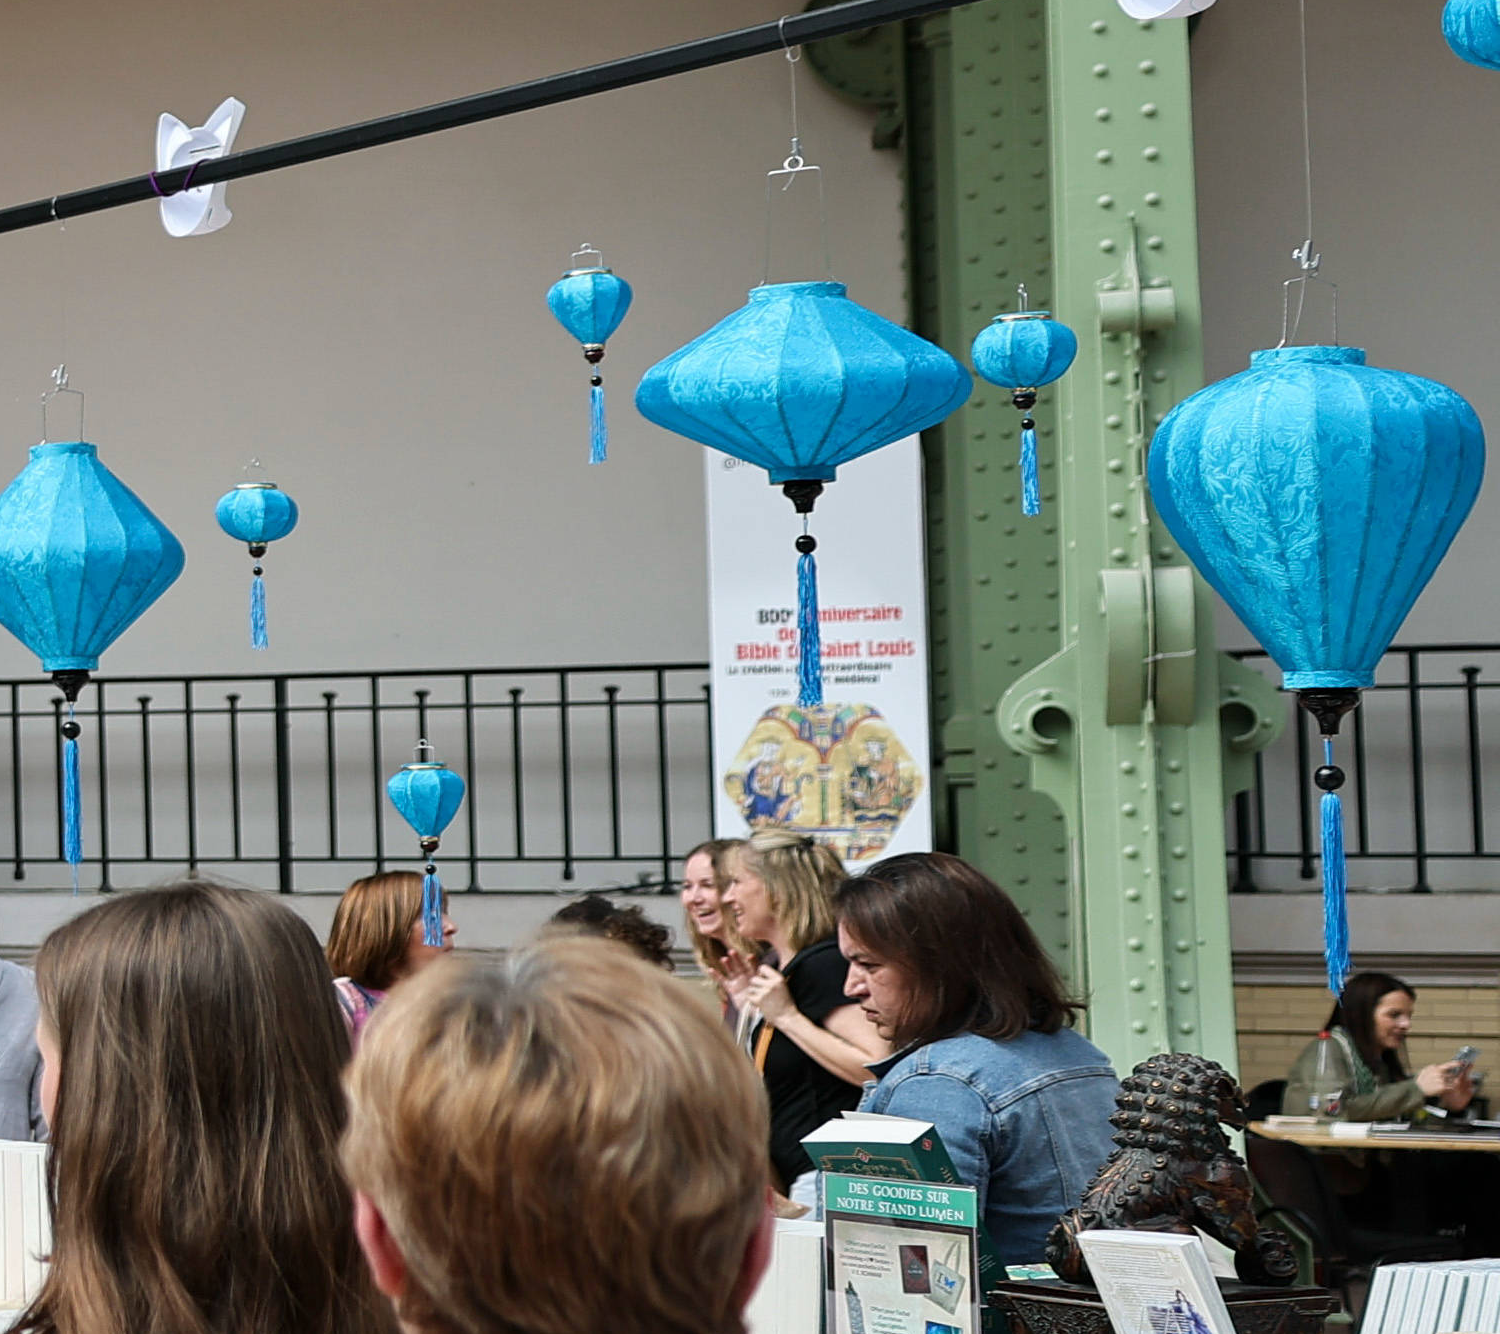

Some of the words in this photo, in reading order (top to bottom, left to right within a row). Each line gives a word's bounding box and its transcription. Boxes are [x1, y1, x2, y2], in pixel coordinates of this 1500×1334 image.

[868, 639, 916, 657] Louis
[848, 1182, 869, 1194] DES
[872, 1184, 923, 1201] GOODIES
[926, 1191, 950, 1204] SUR
[837, 1197, 875, 1212] NOTRE
[879, 1201, 916, 1216] STAND
[919, 1205, 964, 1221] LUMEN
